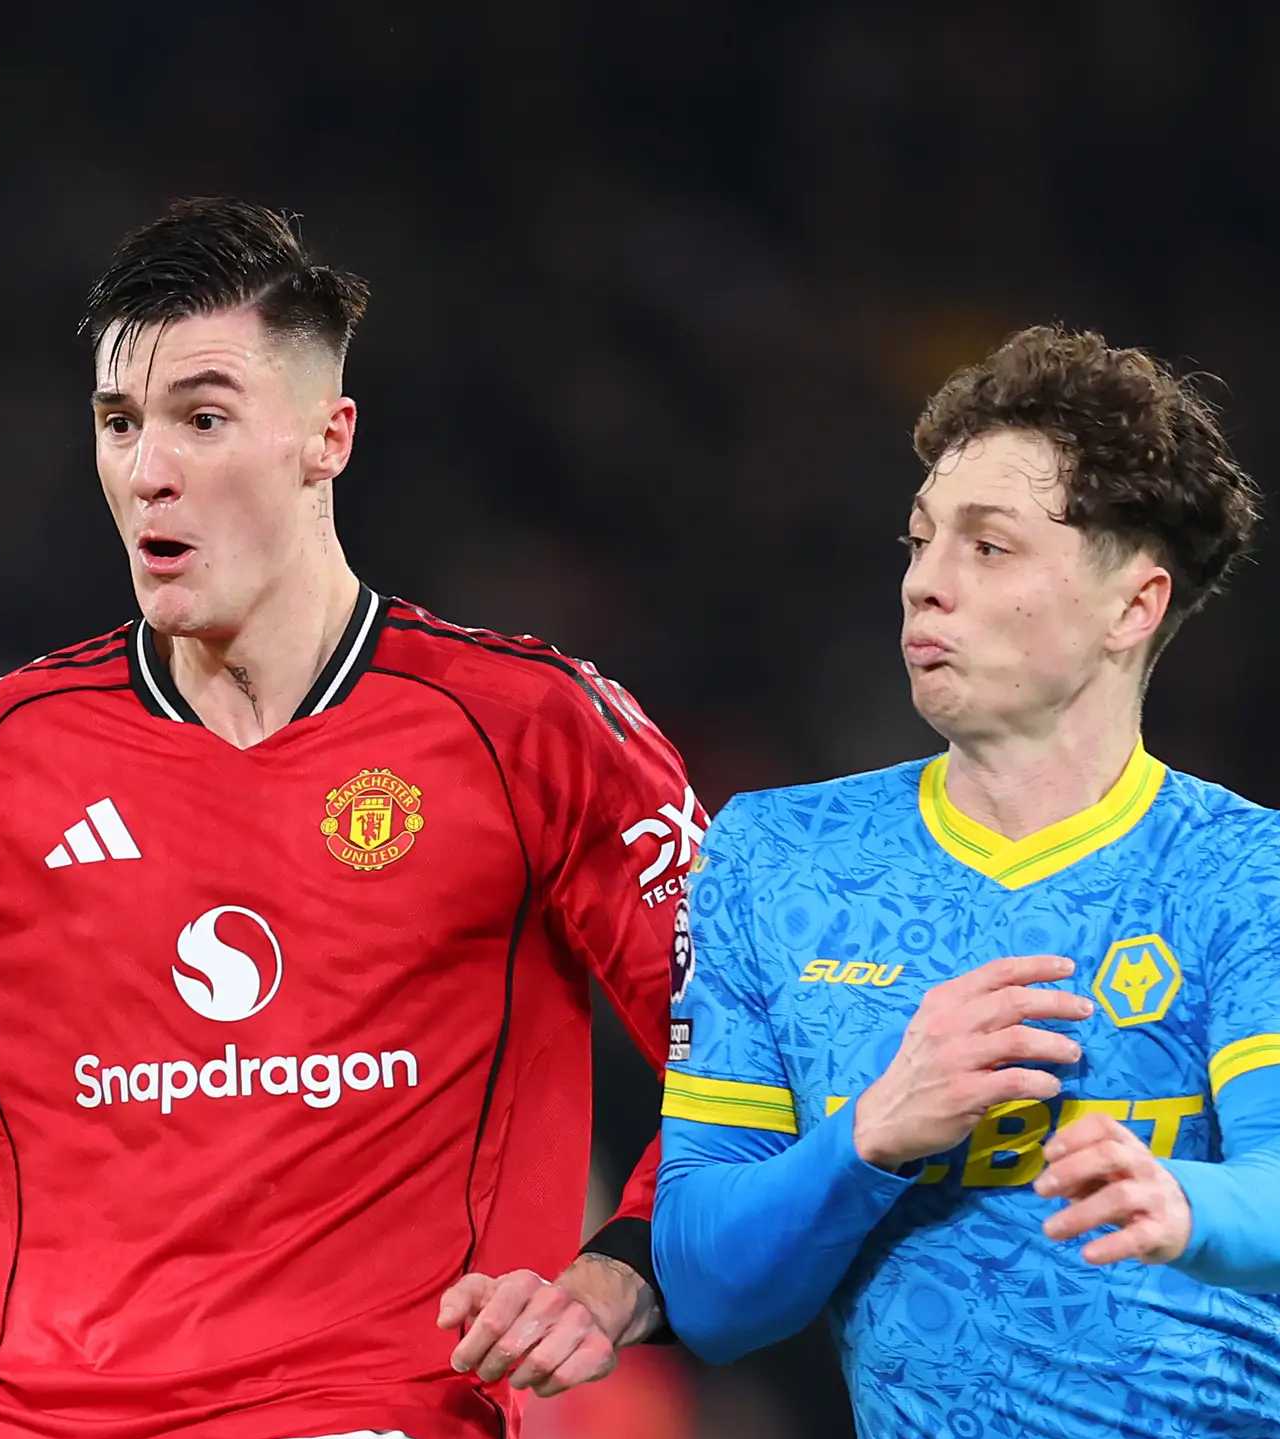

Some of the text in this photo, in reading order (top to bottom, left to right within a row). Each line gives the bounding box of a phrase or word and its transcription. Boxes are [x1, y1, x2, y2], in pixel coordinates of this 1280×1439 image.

[332, 776, 414, 811] MANCHESTER
[341, 846, 399, 864] UNITED
[799, 959, 904, 987] SUDU
[74, 1043, 418, 1114] Snapdragon
